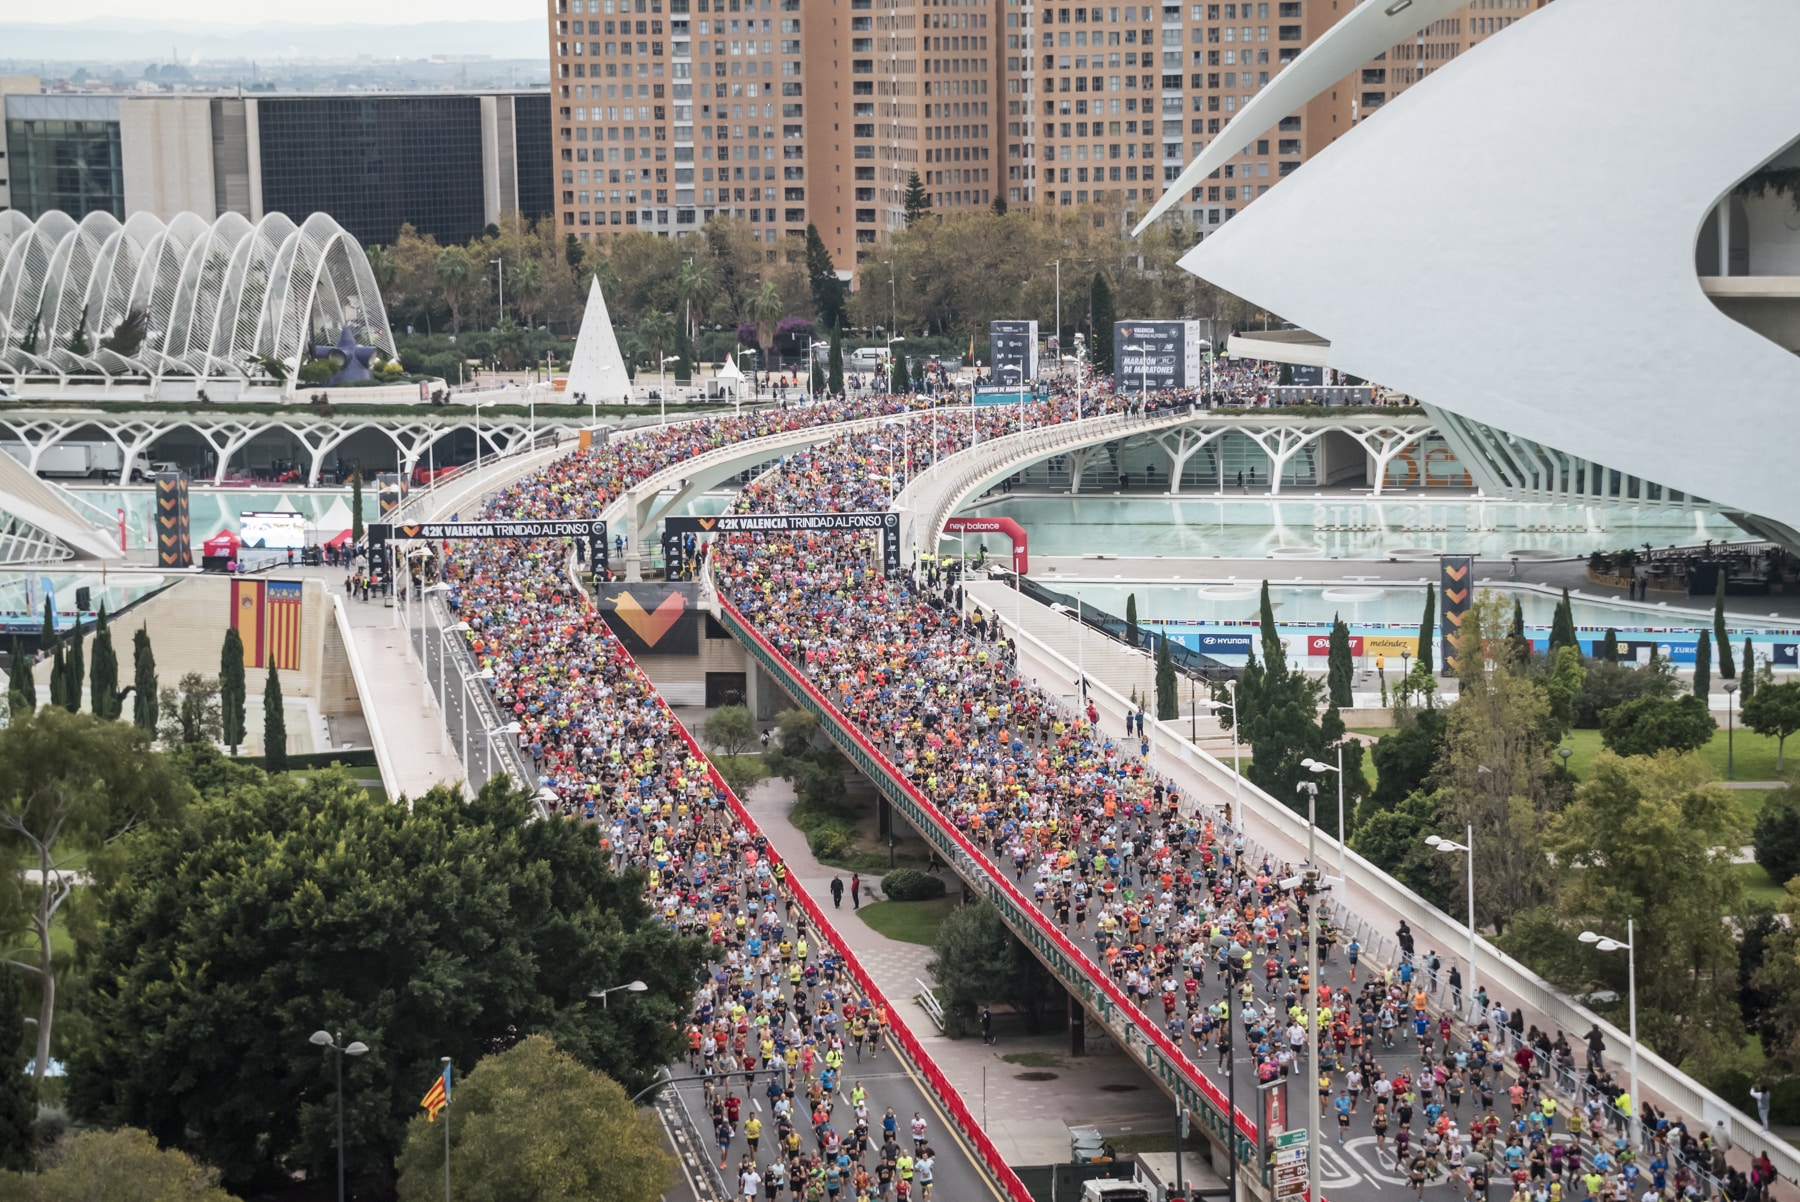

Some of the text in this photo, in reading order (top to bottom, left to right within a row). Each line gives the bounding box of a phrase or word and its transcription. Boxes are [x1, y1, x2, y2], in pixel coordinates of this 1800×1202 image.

[1123, 366, 1174, 374] DE MARATONES
[717, 515, 882, 530] 42K VALENCIA TRINIDAD ALFONSO
[966, 522, 1000, 530] balance
[421, 522, 589, 537] 42K VALENCIA TRINIDAD ALFONSO
[1370, 639, 1408, 649] meléndez
[1673, 646, 1697, 654] ZURIC
